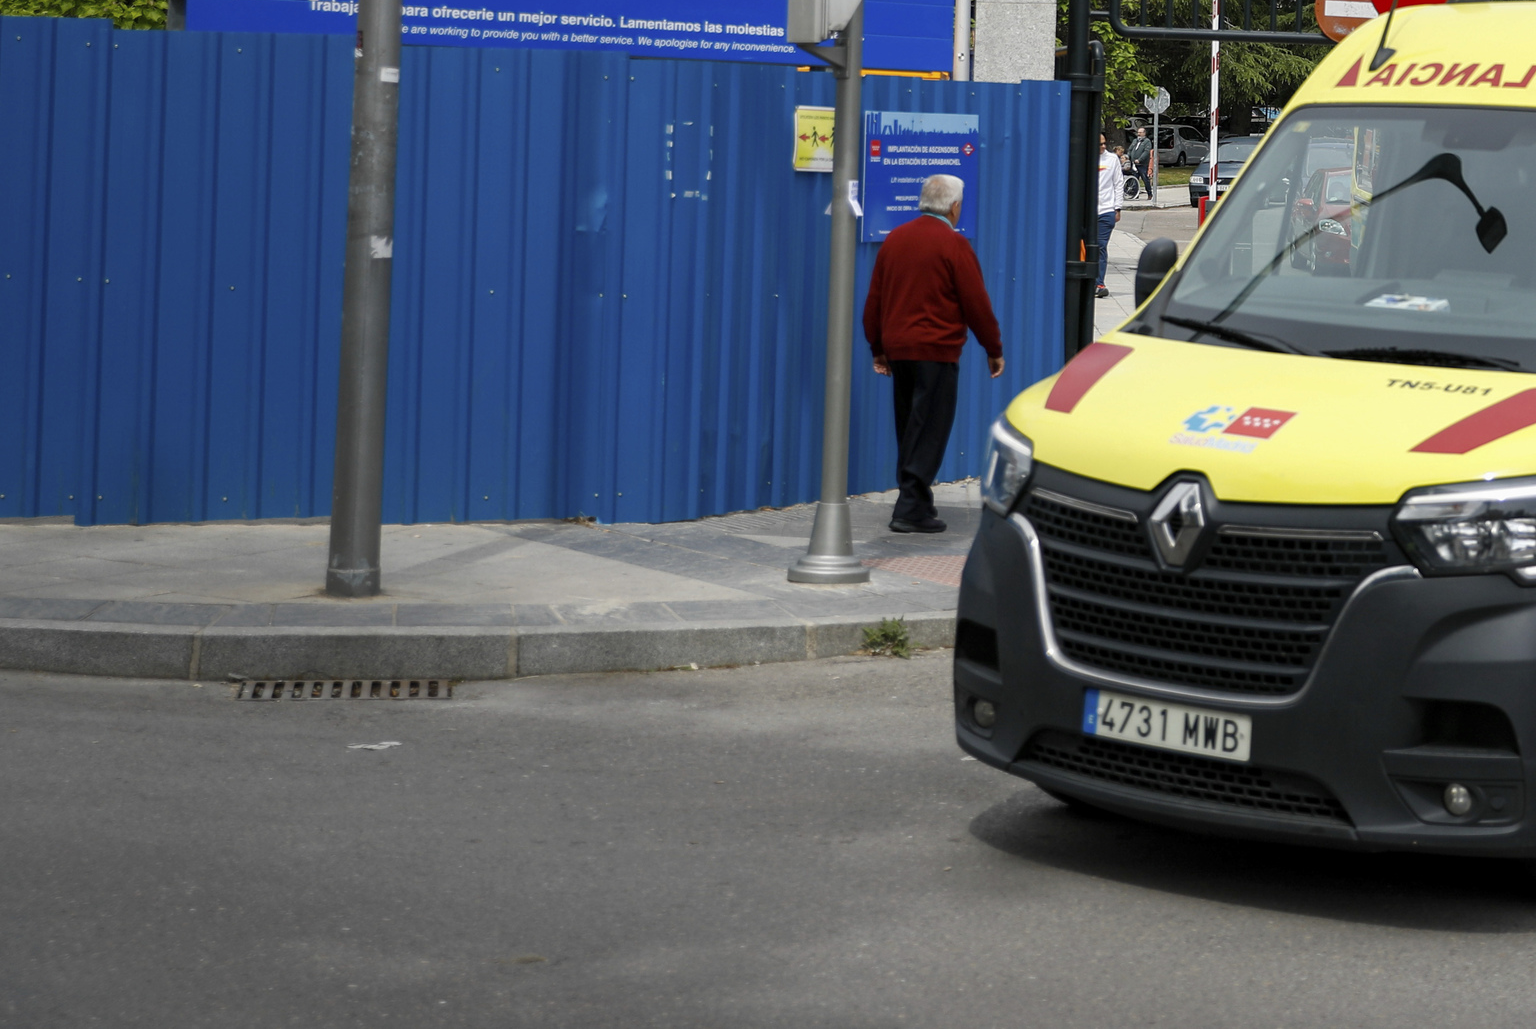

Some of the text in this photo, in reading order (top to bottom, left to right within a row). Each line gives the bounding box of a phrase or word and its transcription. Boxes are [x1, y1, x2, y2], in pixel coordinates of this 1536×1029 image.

[497, 11, 515, 22] un
[519, 12, 557, 26] mejor
[561, 14, 617, 28] servicio.
[620, 16, 701, 32] Lamentamos
[726, 23, 785, 37] molestias
[411, 25, 428, 34] are
[429, 26, 469, 39] working
[470, 28, 481, 38] to
[481, 28, 519, 40] provide
[520, 31, 539, 42] you
[540, 31, 561, 42] with
[561, 34, 569, 42] a
[571, 33, 598, 44] better
[600, 36, 635, 46] service.
[638, 36, 652, 46] We
[654, 37, 699, 50] apologise
[700, 40, 713, 49] for
[714, 42, 730, 52] any
[731, 41, 796, 53] inconvenience.
[1387, 378, 1493, 396] TN5-U81
[1101, 699, 1168, 742] 4731
[1182, 712, 1239, 753] MWB
